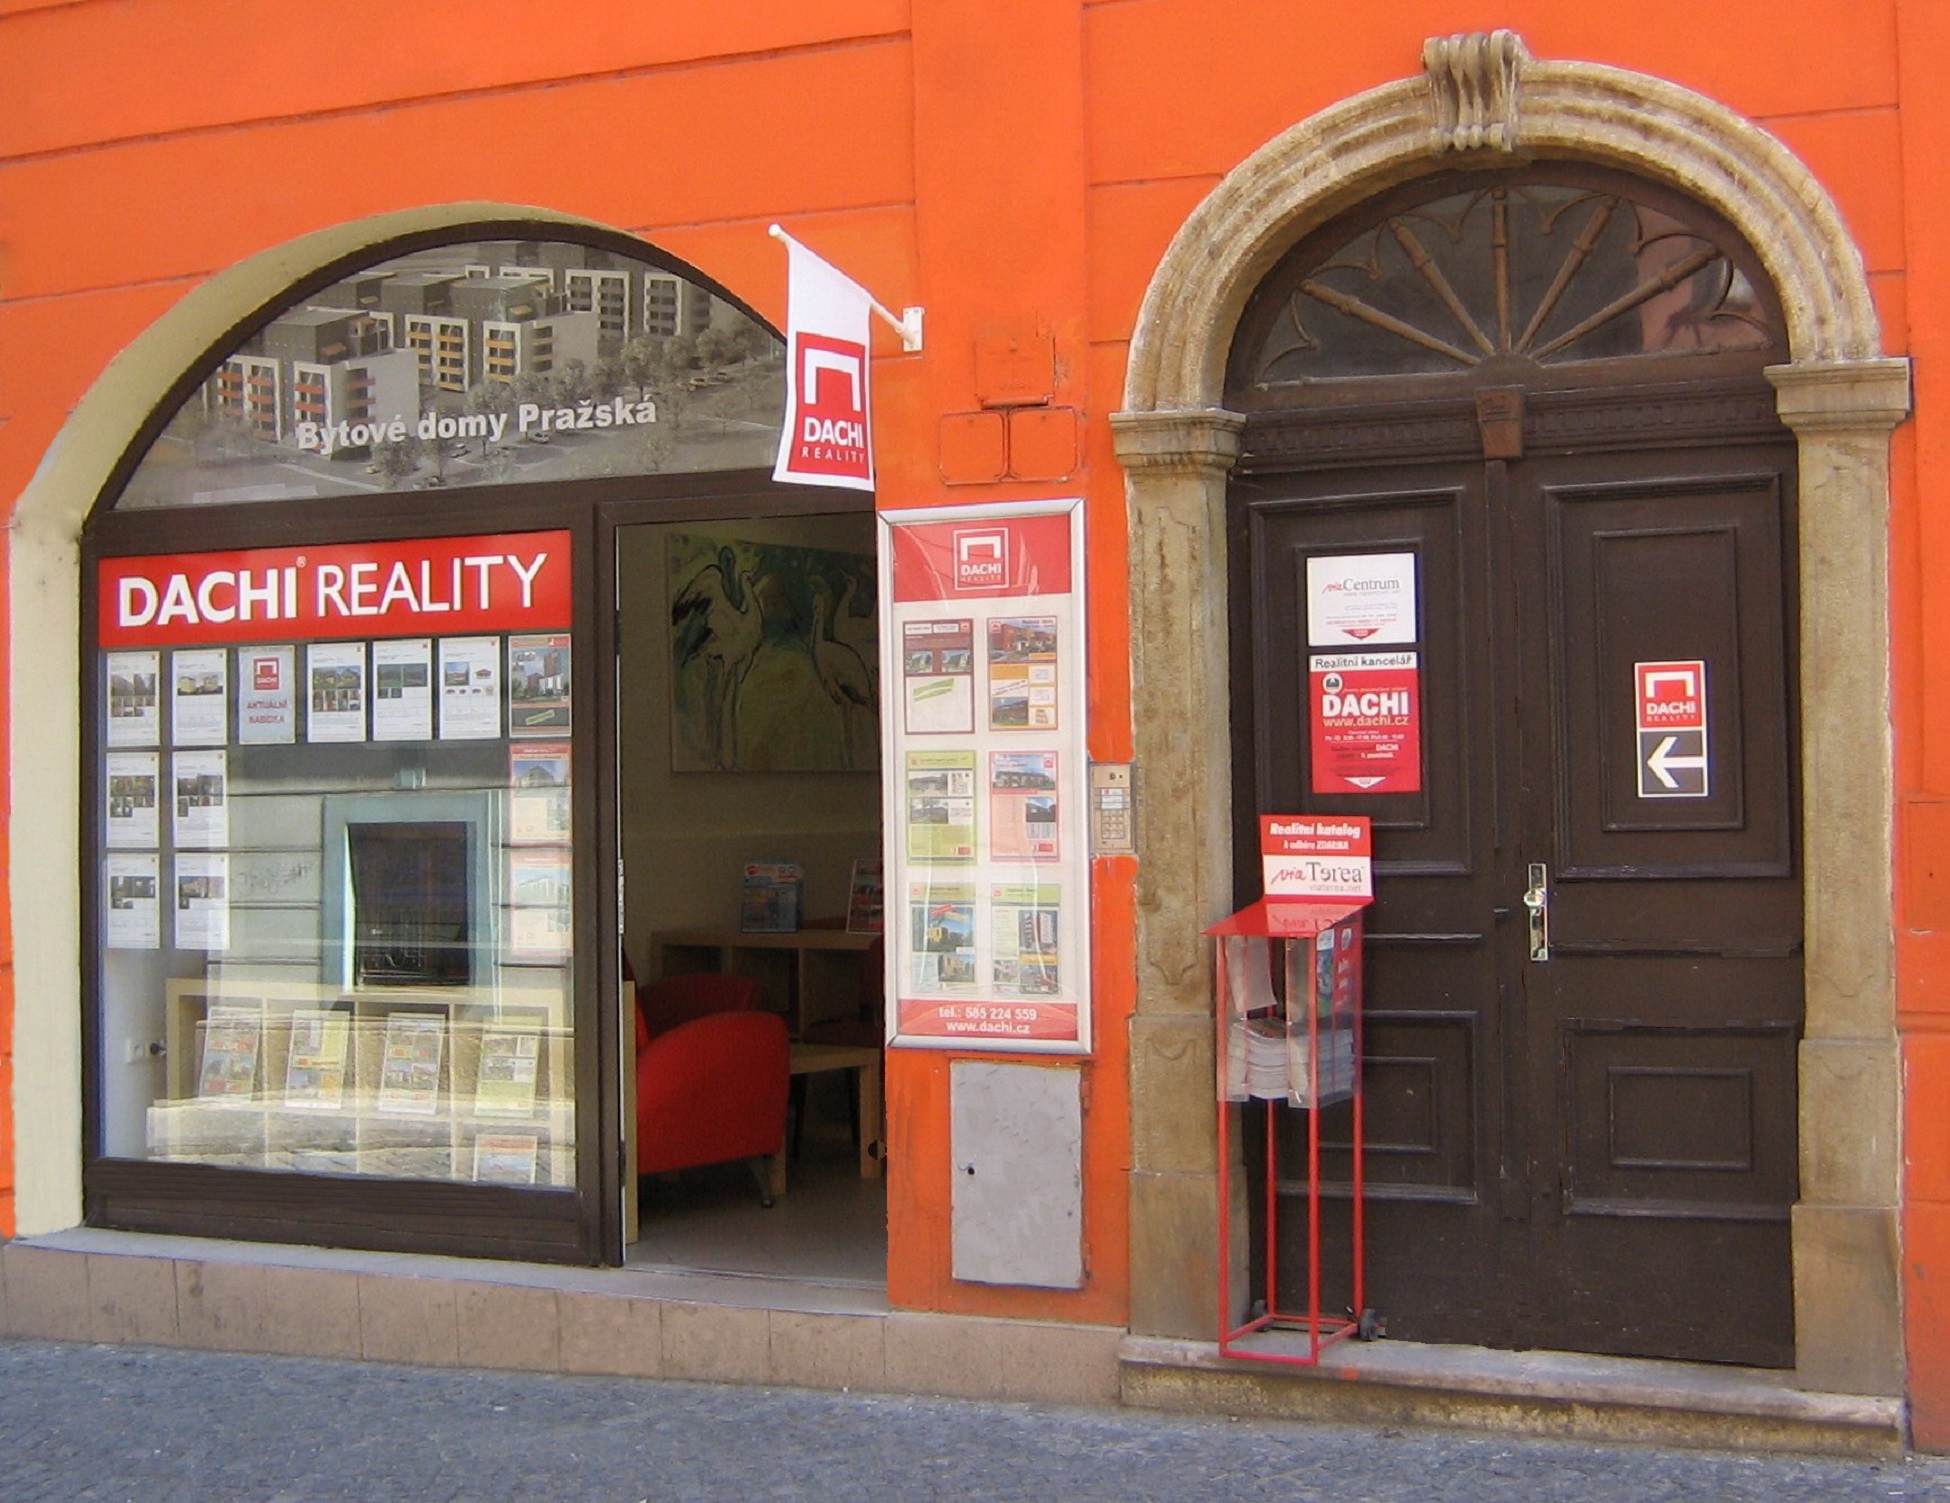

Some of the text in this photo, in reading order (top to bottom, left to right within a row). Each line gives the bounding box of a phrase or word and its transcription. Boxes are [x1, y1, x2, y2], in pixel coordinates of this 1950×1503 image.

[298, 394, 657, 454] Bytové domy Pražská
[803, 416, 864, 448] DACHI
[801, 446, 865, 463] REALITY
[960, 562, 1002, 576] DACHI
[316, 553, 548, 617] REALITY
[1322, 692, 1408, 717] DACHI
[1646, 700, 1696, 715] DACHI
[1322, 715, 1410, 727] www.dachi.cz
[1316, 822, 1361, 839] katalog
[990, 1008, 1012, 1020] 224
[946, 1021, 1030, 1034] www.dachi.cz
